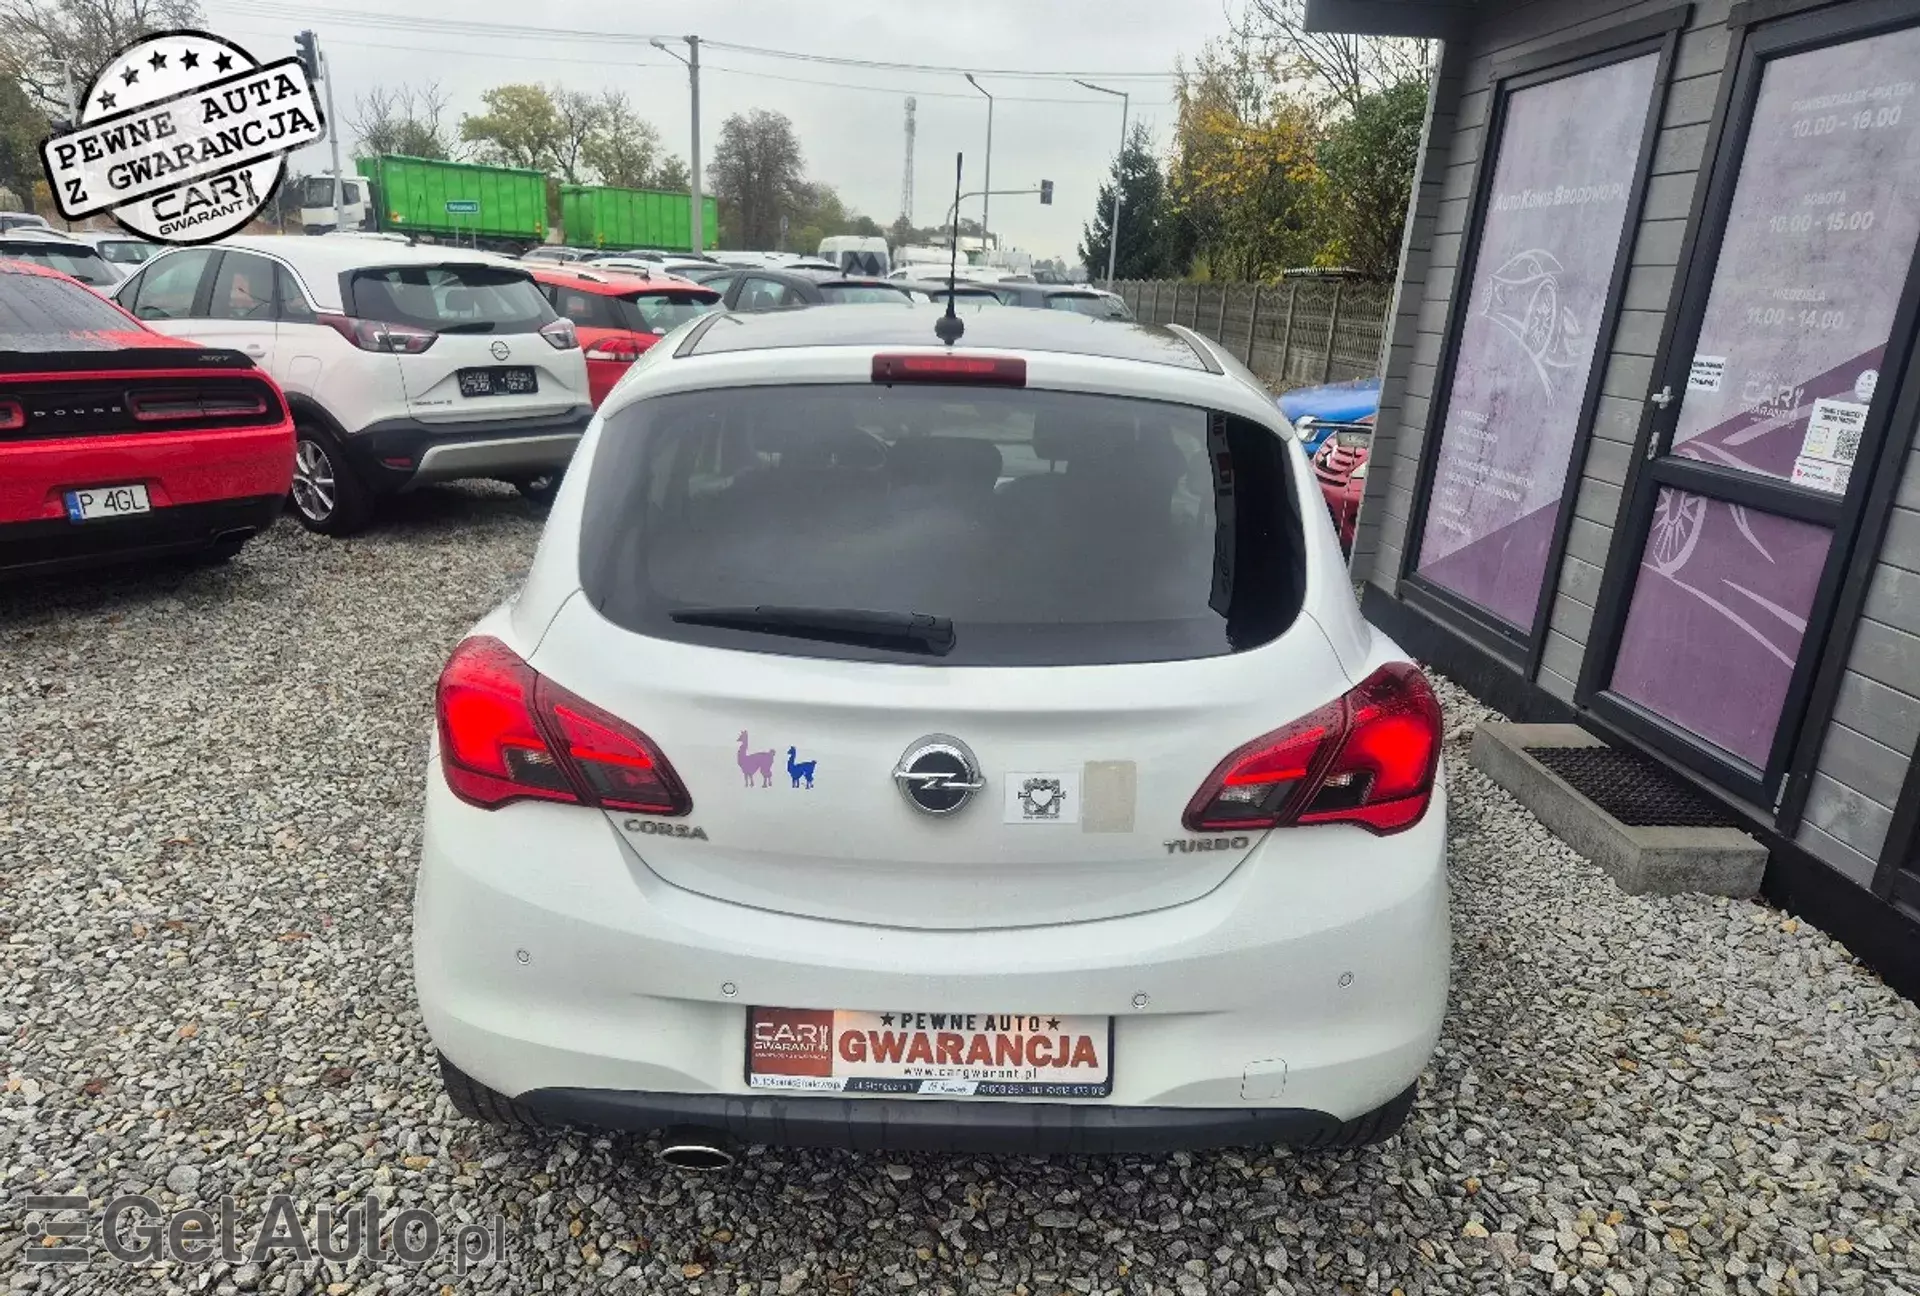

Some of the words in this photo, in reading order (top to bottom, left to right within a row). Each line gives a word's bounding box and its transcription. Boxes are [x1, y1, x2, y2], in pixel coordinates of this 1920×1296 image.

[1791, 114, 1838, 138] 10.00
[1769, 213, 1812, 233] 10.00
[1826, 209, 1875, 231] 15.00
[1799, 308, 1845, 330] 14.00
[79, 492, 95, 516] P
[104, 489, 146, 512] 4GL
[624, 819, 709, 841] CORSA
[1163, 836, 1250, 854] TURBO
[755, 1022, 818, 1043] CAR
[900, 1012, 977, 1031] PEWNE
[984, 1015, 1041, 1032] AUTO
[753, 1041, 818, 1052] GWARANT
[838, 1029, 1099, 1068] GWARANCJA
[903, 1066, 1038, 1080] www.cargwarant.pl
